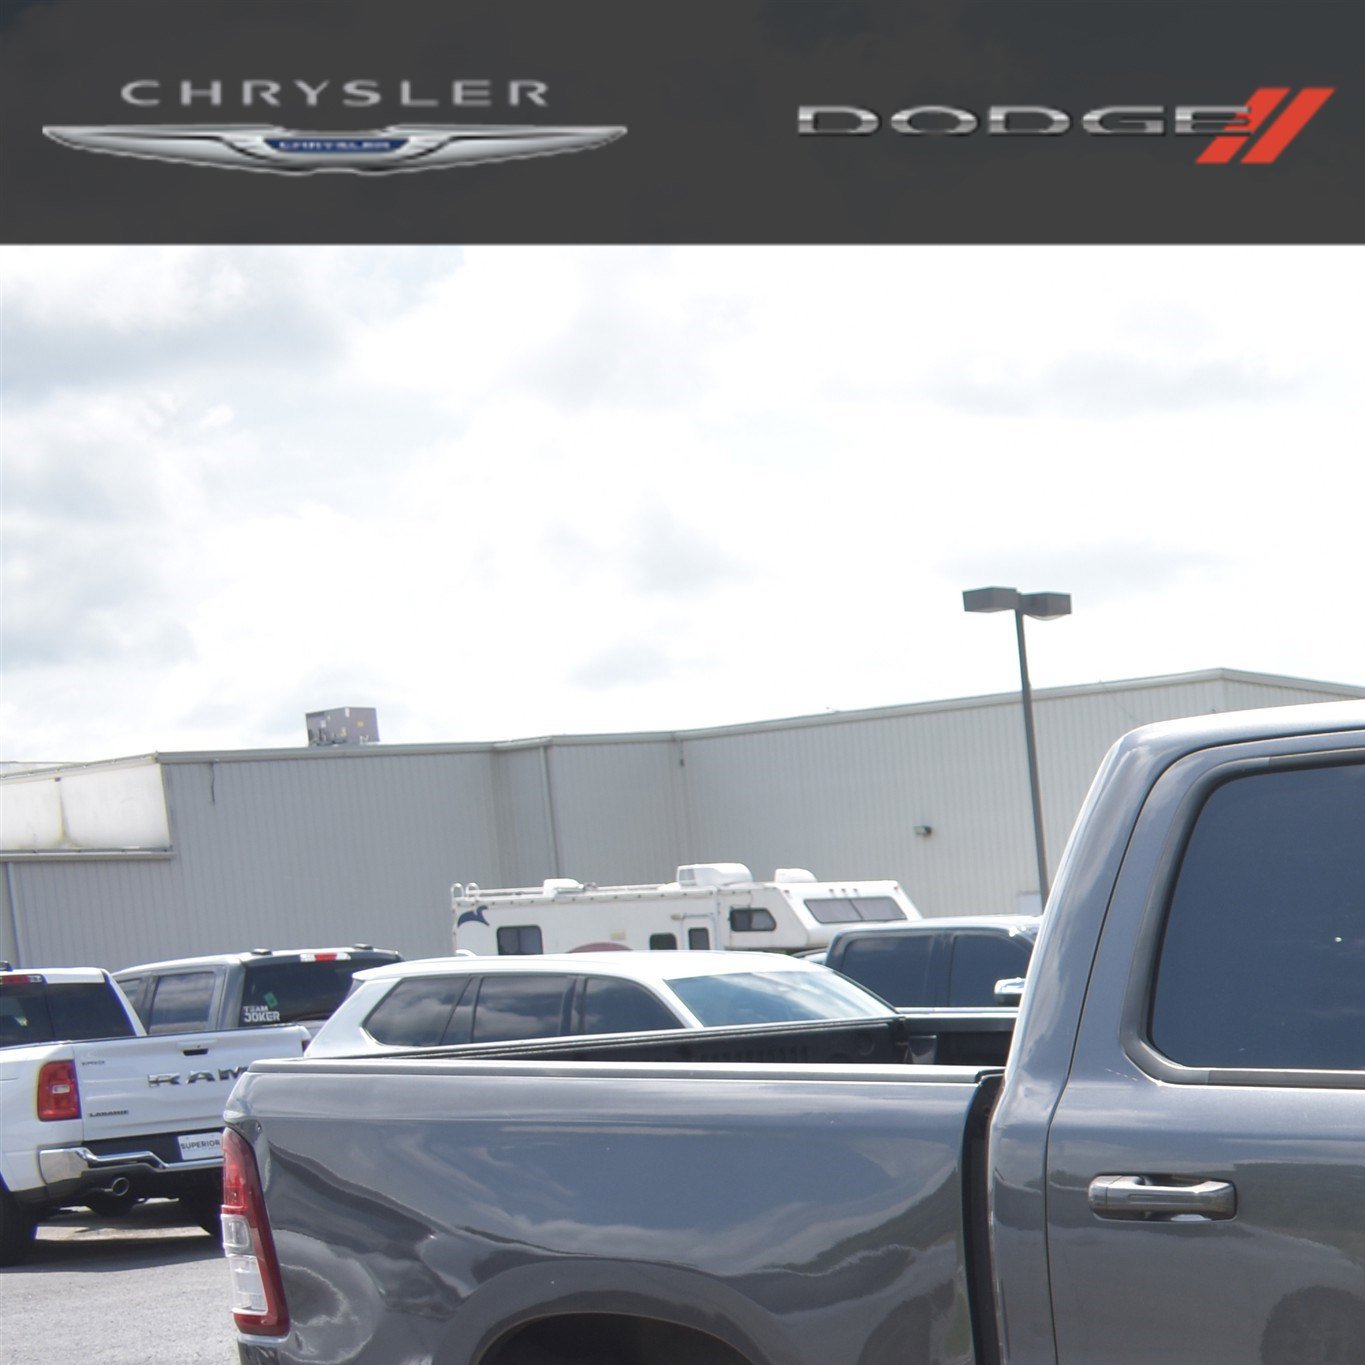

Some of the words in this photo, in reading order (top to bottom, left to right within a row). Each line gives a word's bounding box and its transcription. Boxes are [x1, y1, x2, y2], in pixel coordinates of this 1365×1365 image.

[244, 1011, 281, 1023] JOKER
[147, 1066, 249, 1088] RAM
[180, 1138, 221, 1150] SUPERIOR
